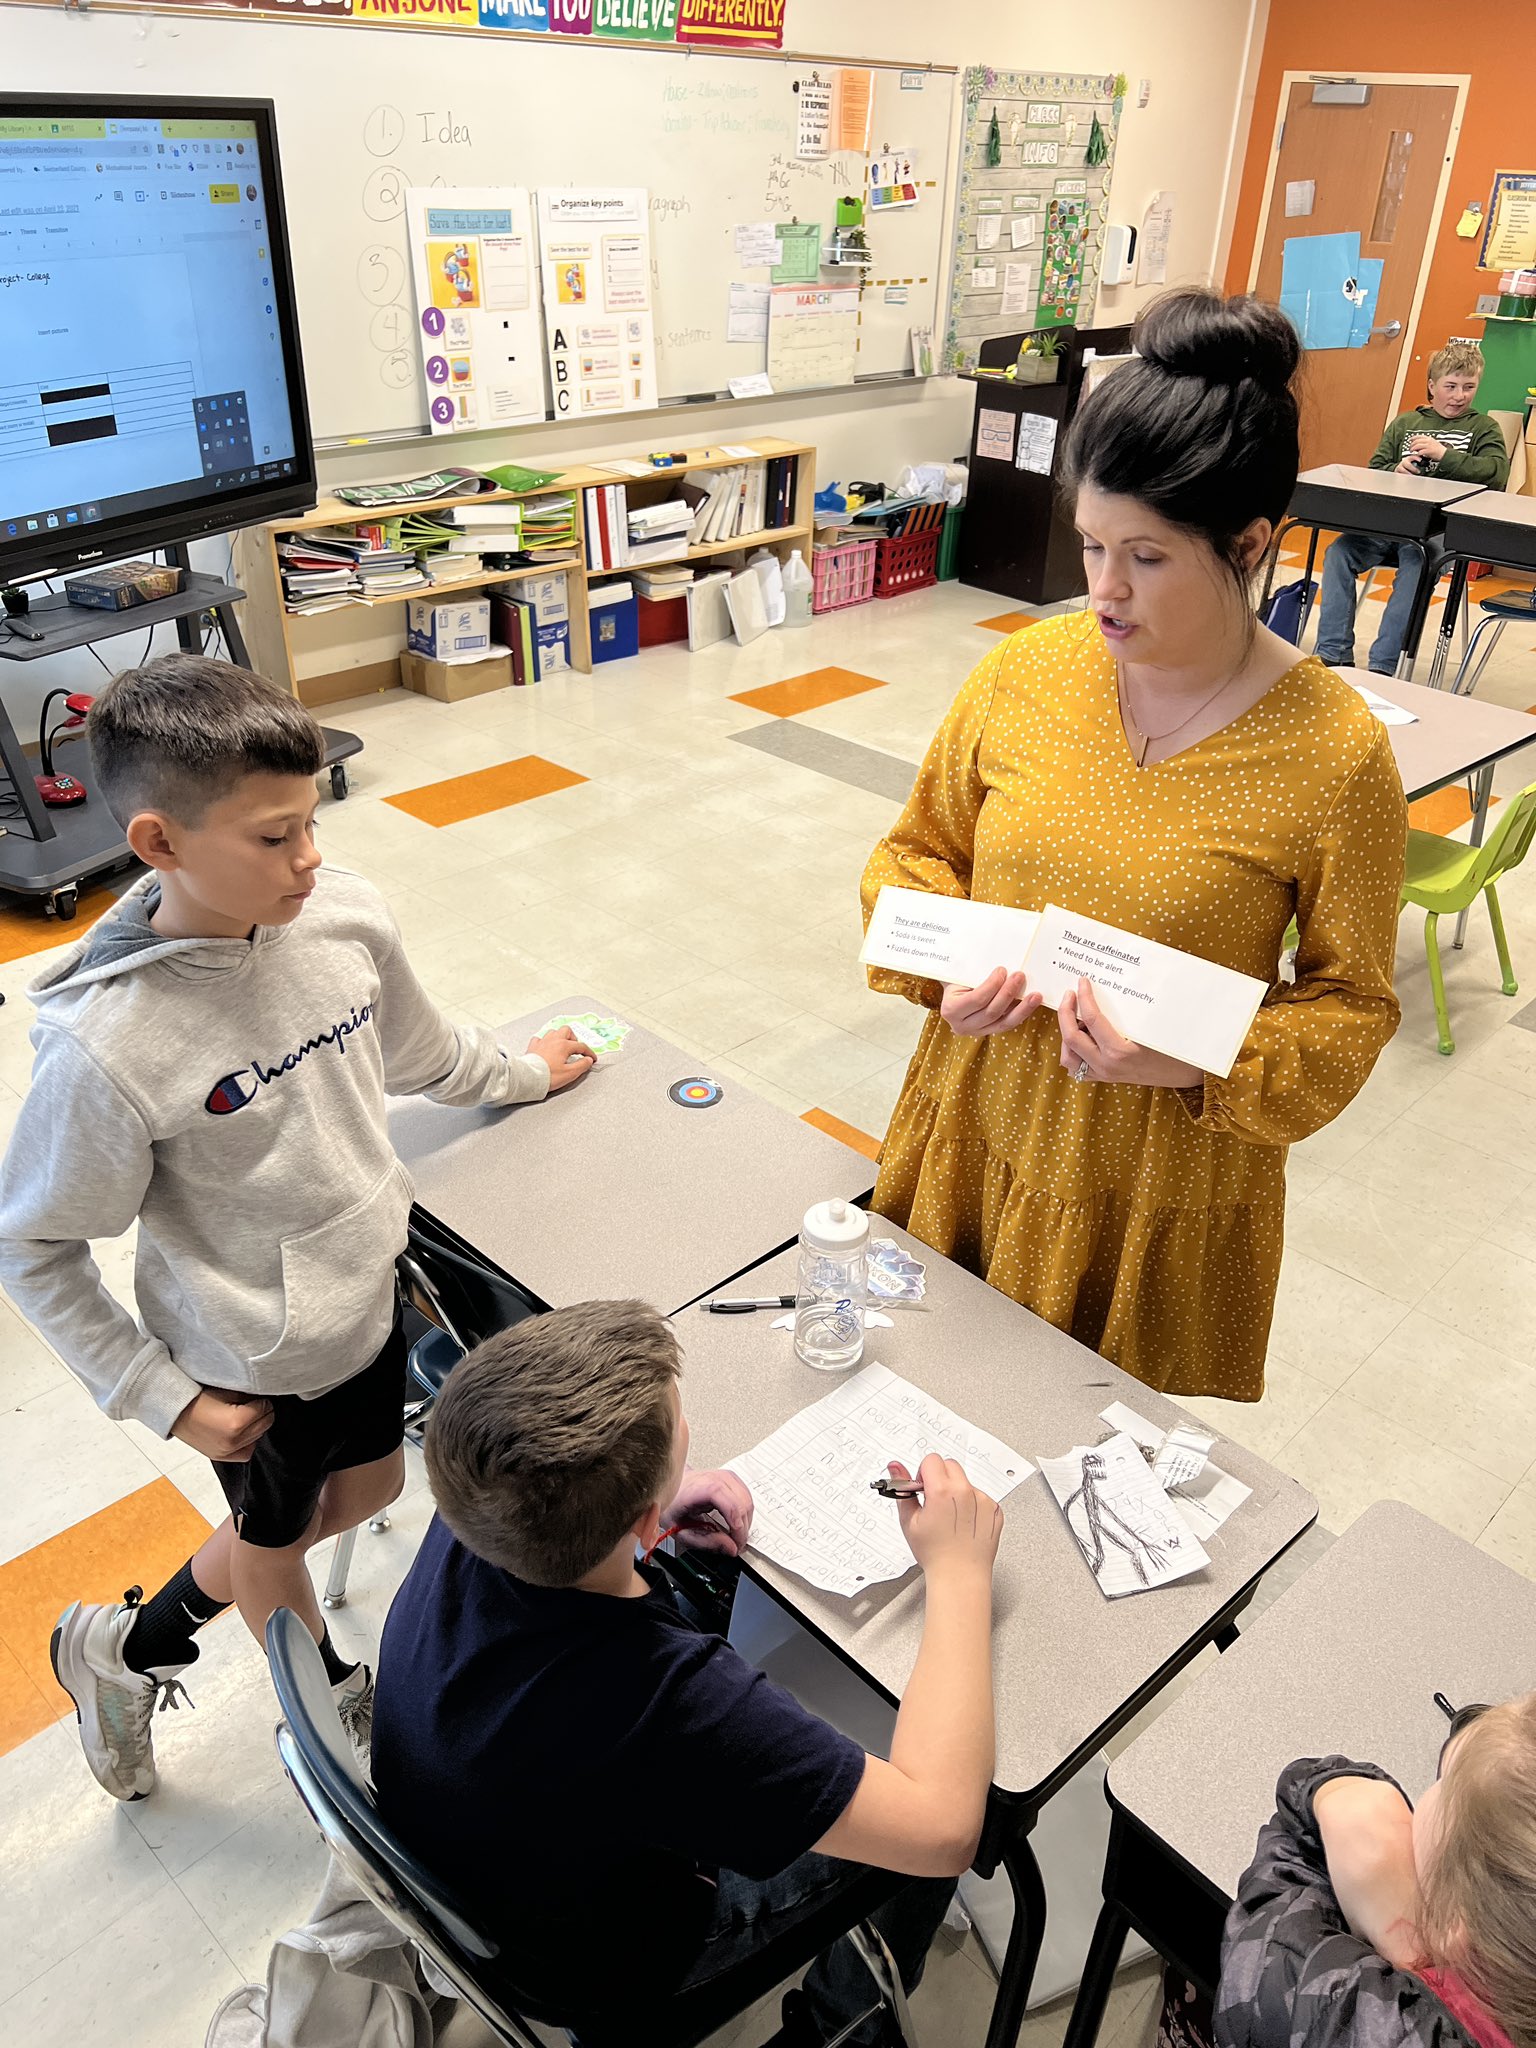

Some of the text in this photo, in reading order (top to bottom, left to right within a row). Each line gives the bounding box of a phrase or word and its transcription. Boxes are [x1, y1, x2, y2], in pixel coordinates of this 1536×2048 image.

[596, 0, 675, 31] BELIEVE
[416, 111, 472, 147] Idea
[561, 199, 623, 209] Organize key points
[26, 272, 51, 285] College
[796, 294, 830, 306] MARCH
[429, 312, 438, 330] 1
[554, 329, 568, 351] A
[433, 361, 443, 378] 2
[556, 360, 568, 382] B
[558, 390, 569, 411] C
[438, 402, 449, 419] 3
[895, 916, 909, 926] They
[895, 930, 910, 939] Soda
[911, 947, 929, 957] down
[1064, 930, 1141, 965] They are caffeinated.
[1063, 947, 1124, 976] Need to be alert.
[1058, 962, 1089, 979] Without
[1098, 977, 1111, 988] can
[1112, 980, 1122, 992] be
[1123, 986, 1155, 1004] grouchy.
[205, 1002, 375, 1115] Champio
